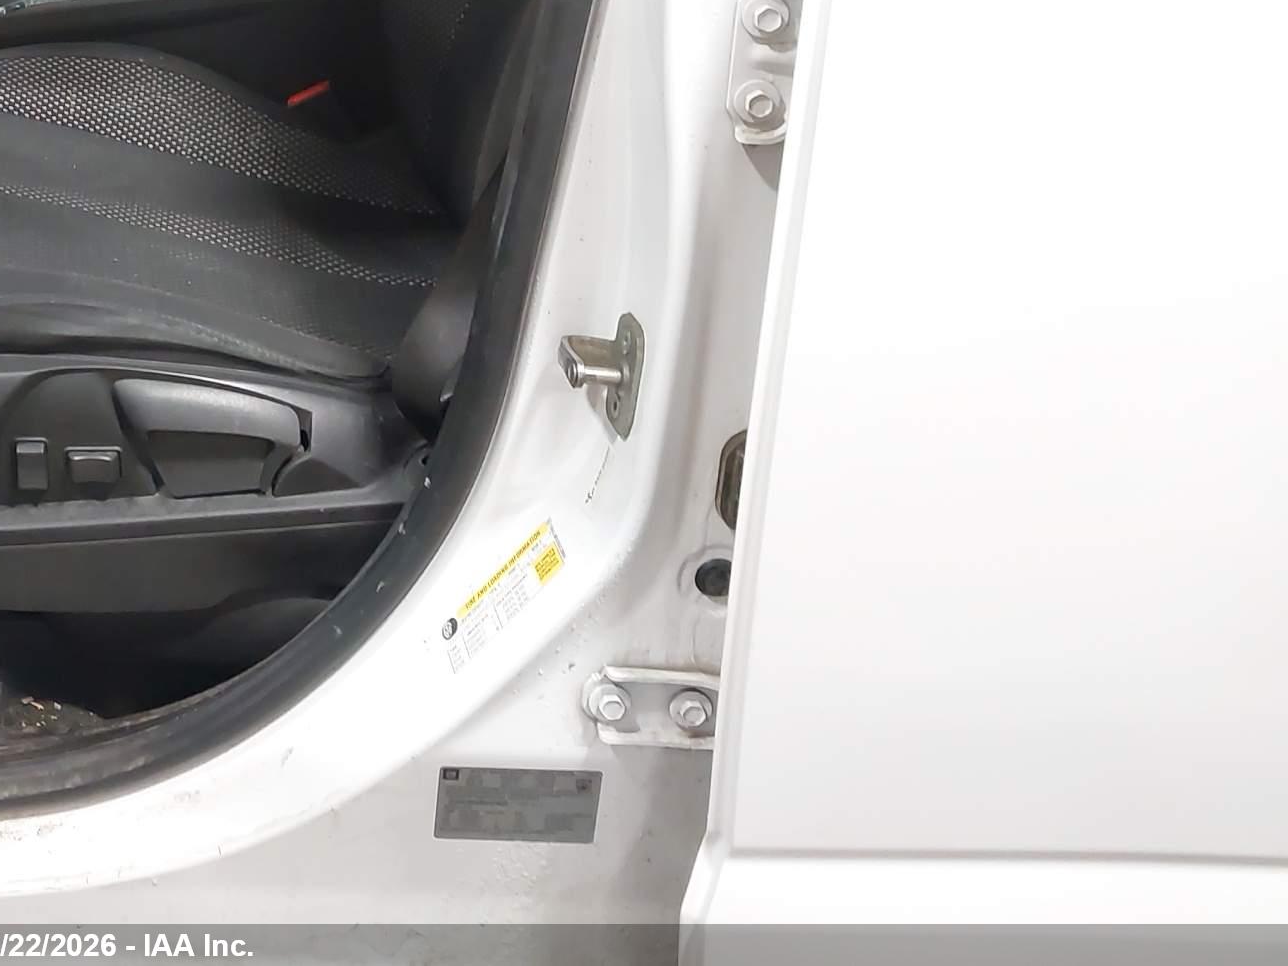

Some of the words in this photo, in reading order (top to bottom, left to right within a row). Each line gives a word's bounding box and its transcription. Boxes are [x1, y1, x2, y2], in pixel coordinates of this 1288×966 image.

[477, 585, 488, 600] AND
[487, 563, 509, 588] LOADING
[508, 529, 541, 567] INFORMATION
